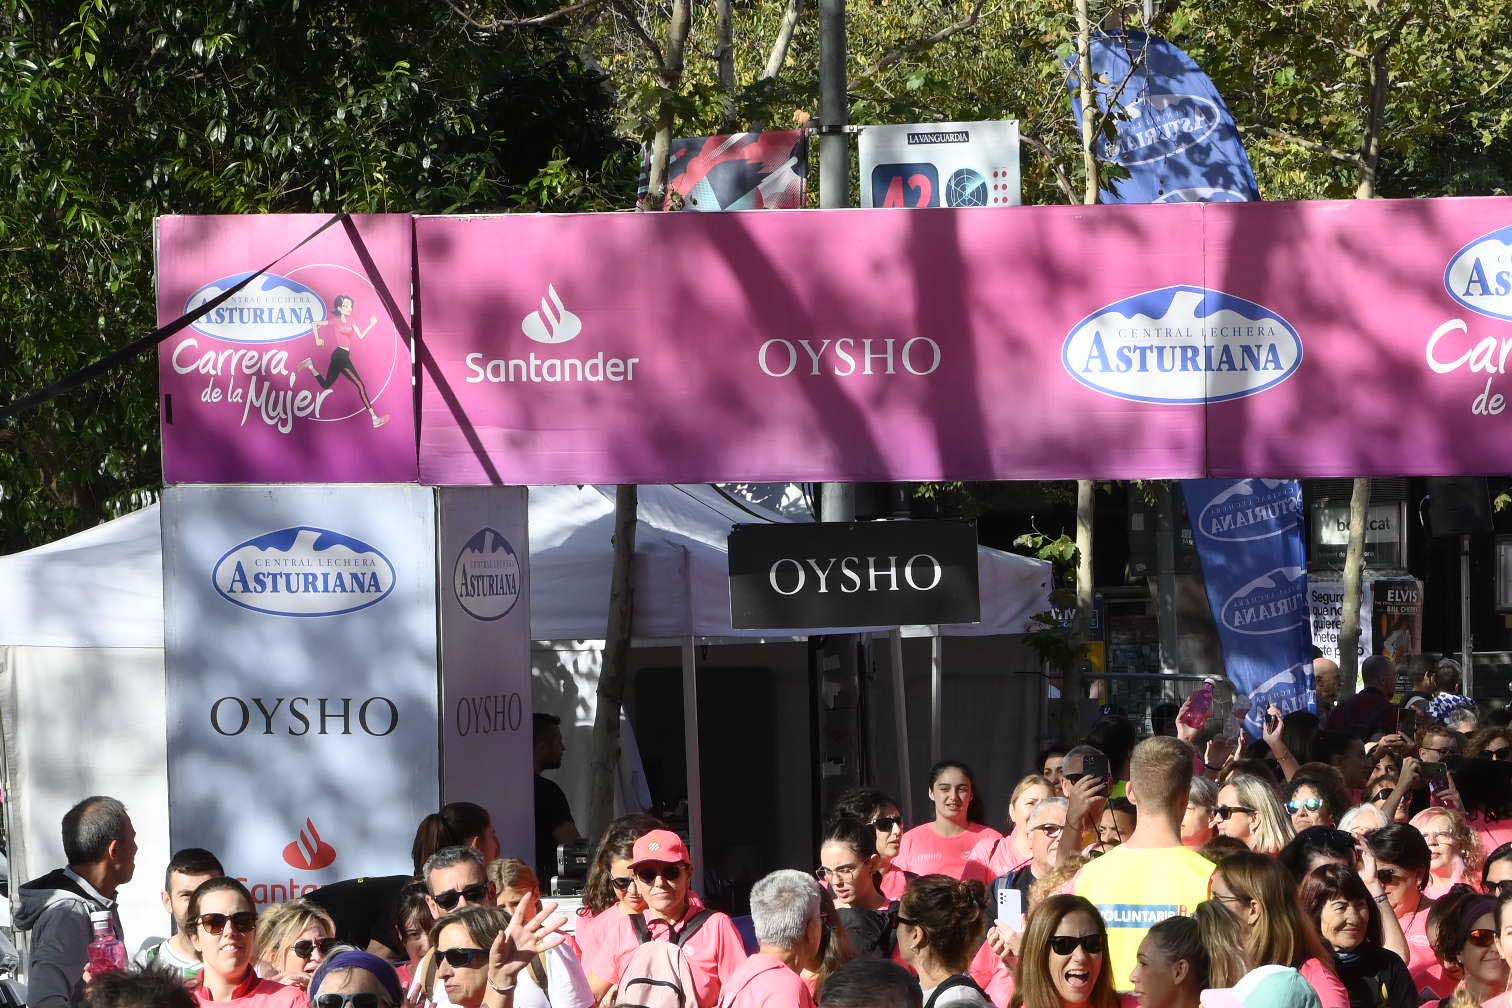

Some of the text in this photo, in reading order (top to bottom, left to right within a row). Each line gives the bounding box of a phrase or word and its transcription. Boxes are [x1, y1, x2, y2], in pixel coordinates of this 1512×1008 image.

[1118, 326, 1276, 339] CENTRAL LECHERA
[172, 338, 290, 376] Carrera
[465, 351, 639, 383] Santander
[758, 336, 941, 378] OYSHO
[1082, 329, 1284, 375] ASTURIANA
[201, 374, 333, 434] de la Mujer
[1470, 377, 1506, 417] de
[227, 560, 383, 594] ASTURIANA
[255, 557, 376, 567] CENTRAL LECHERA
[459, 564, 517, 598] ASTURIANA
[769, 553, 943, 597] OYSHO
[1313, 606, 1329, 617] que
[1387, 589, 1418, 602] ELVIS
[210, 696, 399, 737] OYSHO
[456, 692, 522, 737] OYSHO
